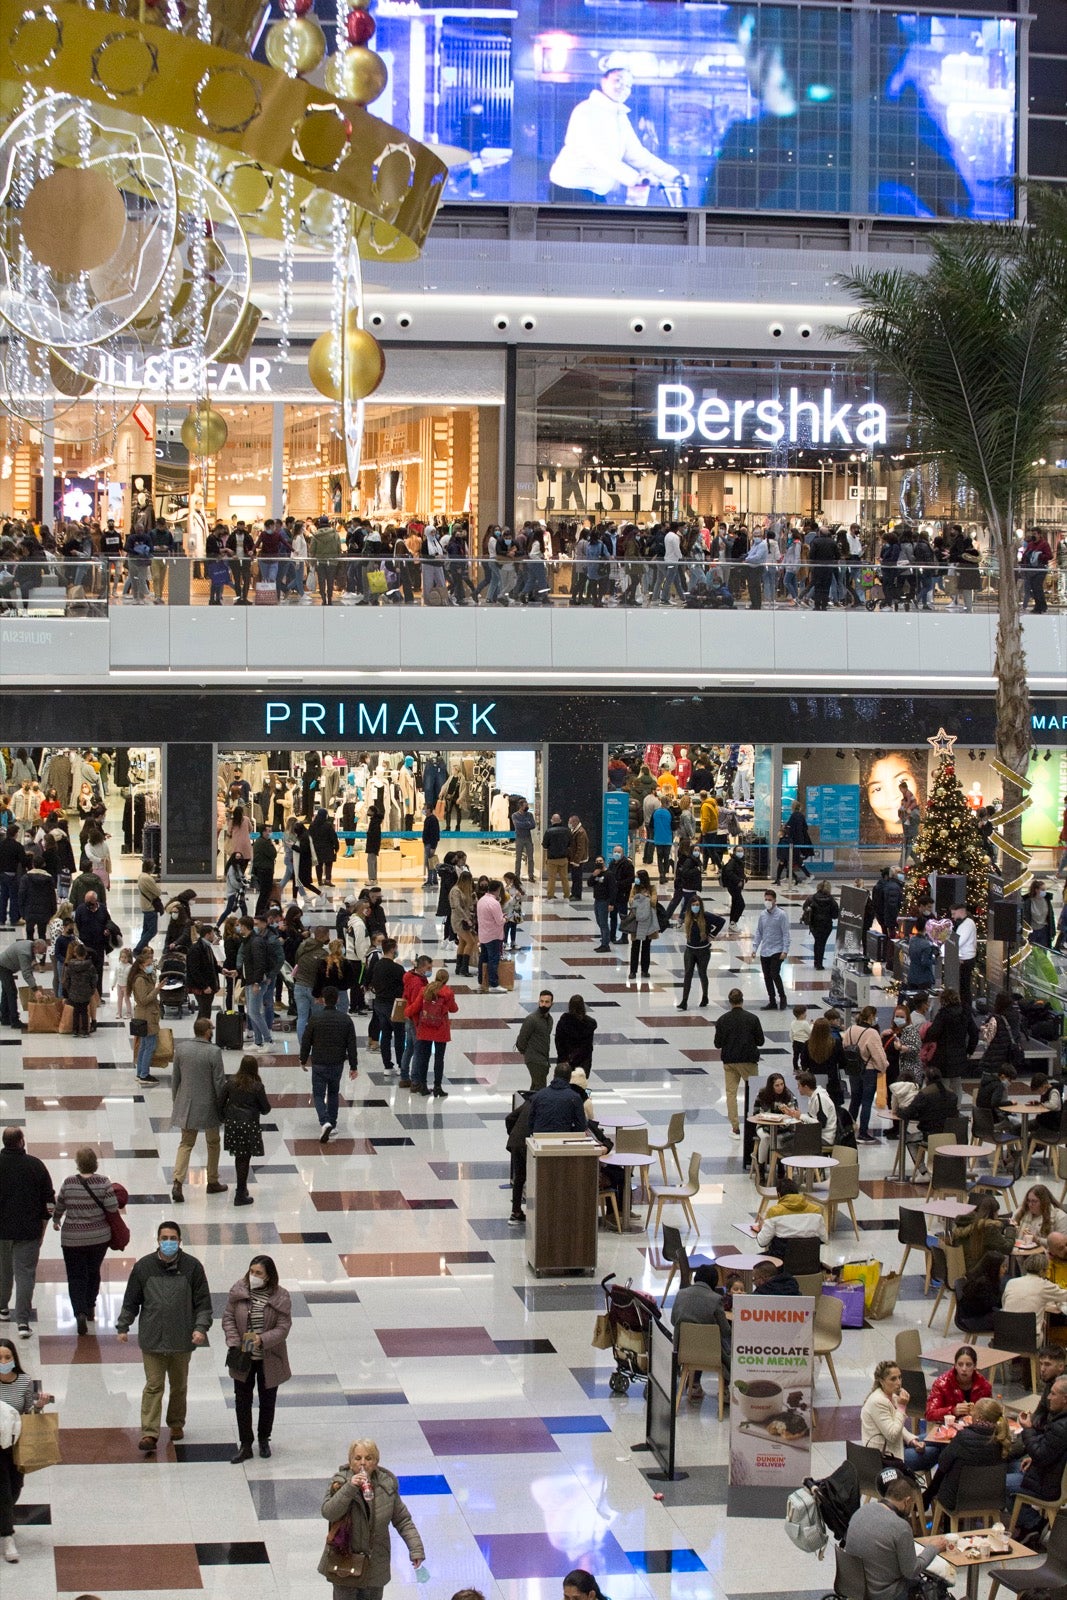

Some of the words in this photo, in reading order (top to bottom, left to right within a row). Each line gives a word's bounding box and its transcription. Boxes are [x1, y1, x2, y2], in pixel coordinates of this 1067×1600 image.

[656, 383, 888, 446] Bershka
[266, 702, 497, 735] PRIMARK
[740, 1309, 809, 1323] DUNKIN'
[736, 1345, 810, 1356] CHOCOLATE
[737, 1355, 764, 1365] CON
[766, 1356, 807, 1367] MENTA
